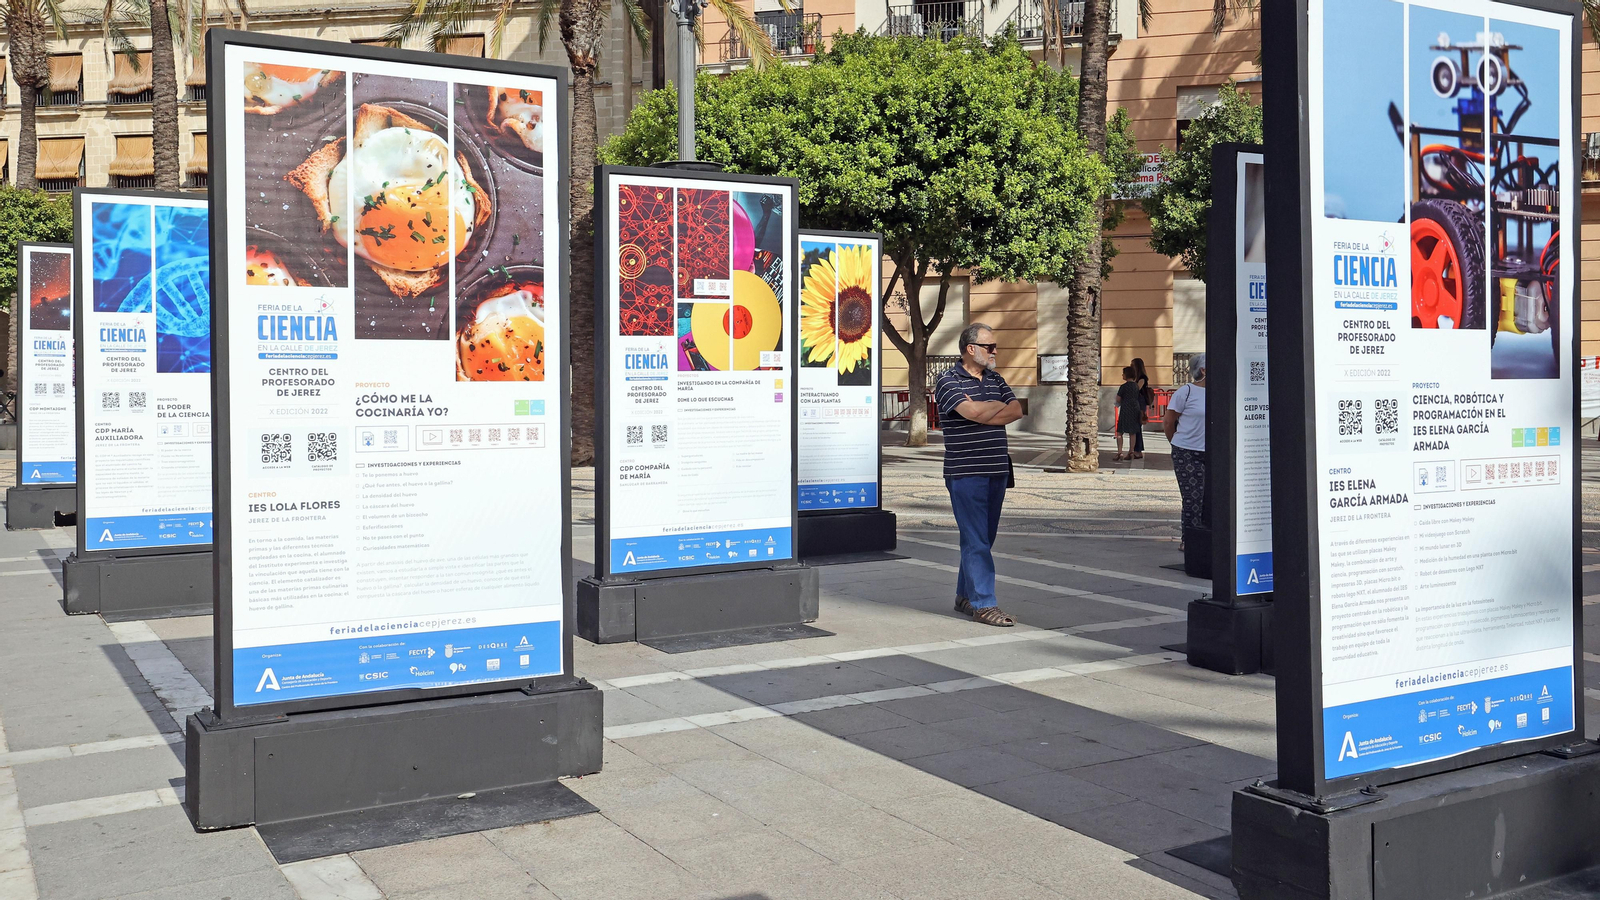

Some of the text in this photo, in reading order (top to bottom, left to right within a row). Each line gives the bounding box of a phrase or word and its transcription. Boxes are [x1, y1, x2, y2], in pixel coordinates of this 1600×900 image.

[1334, 242, 1370, 251] FERIA DE LA
[1334, 255, 1398, 287] CIENCIA
[1334, 291, 1342, 299] EN
[1343, 291, 1351, 299] LA
[1352, 291, 1370, 300] CALLE
[258, 315, 338, 341] CIENCIA
[1343, 320, 1390, 330] CENTRO DEL
[100, 328, 146, 342] CIENCIA
[1338, 333, 1396, 342] PROFESORADO
[34, 340, 66, 350] CIENCIA
[1350, 346, 1385, 354] DE JEREZ
[625, 354, 668, 370] CIENCIA
[1350, 368, 1376, 377] EDICIÓN
[356, 392, 433, 406] ¿CÓMO ME LA
[1412, 391, 1504, 405] CIENCIA, ROBÓTICA Y
[356, 406, 449, 417] COCINARÍA YO?
[1412, 407, 1506, 420] PROGRAMACIÓN EN EL
[1413, 422, 1489, 436] IES ELENA GARCÍA
[1413, 440, 1450, 452] ARMADA
[635, 462, 670, 471] COMPAÑÍA
[1330, 479, 1376, 492] IES ELENA
[1330, 493, 1409, 509] GARCÍA ARMADA
[1423, 502, 1462, 510] INVESTIGACIONES
[248, 501, 341, 513] IES LOLA FLORES
[1364, 512, 1391, 521] FRONTERA
[329, 616, 477, 636] feriadelacienciacepjerez.es
[364, 671, 389, 680] CSIC
[1395, 662, 1509, 689] feriadelacienciacepjerez.es
[1457, 704, 1471, 712] FECYT
[1424, 732, 1442, 742] CSIC
